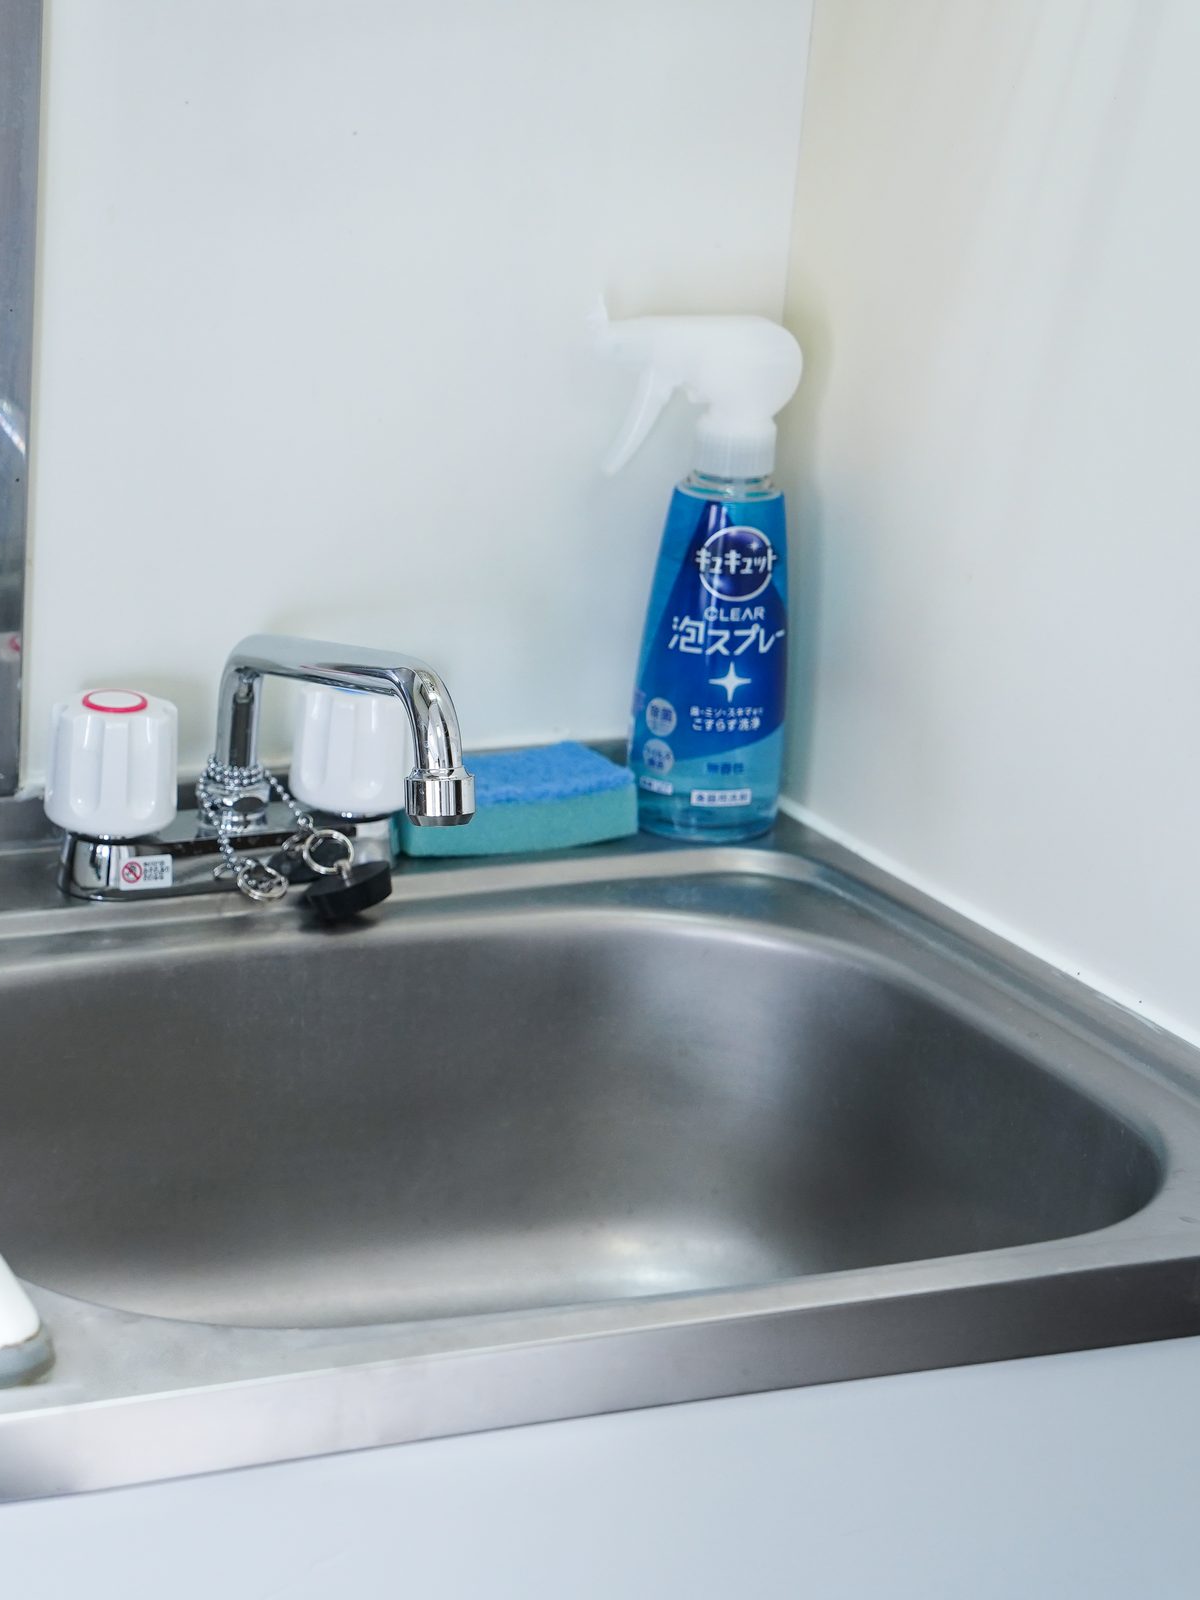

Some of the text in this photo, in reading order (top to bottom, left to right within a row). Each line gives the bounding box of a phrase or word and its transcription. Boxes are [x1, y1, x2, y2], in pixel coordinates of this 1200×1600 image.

[695, 547, 778, 575] キュキュット
[704, 606, 765, 621] CLEAR
[668, 615, 785, 656] 泡スプレー
